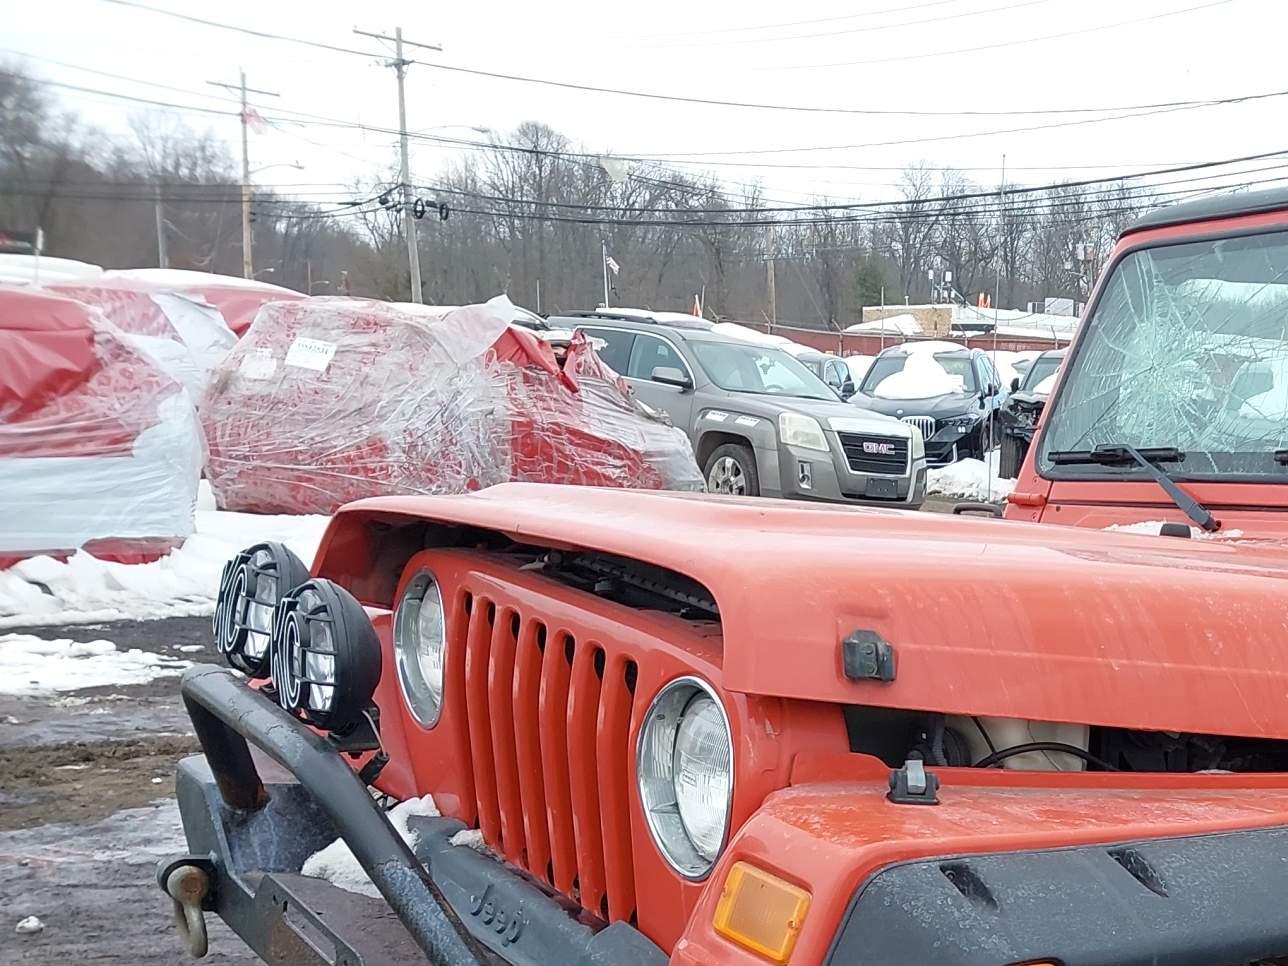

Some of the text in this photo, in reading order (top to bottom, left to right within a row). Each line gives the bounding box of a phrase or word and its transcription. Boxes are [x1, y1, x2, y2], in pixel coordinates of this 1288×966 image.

[862, 441, 896, 455] GMC
[270, 597, 301, 711] KC
[470, 883, 525, 948] Jeep
